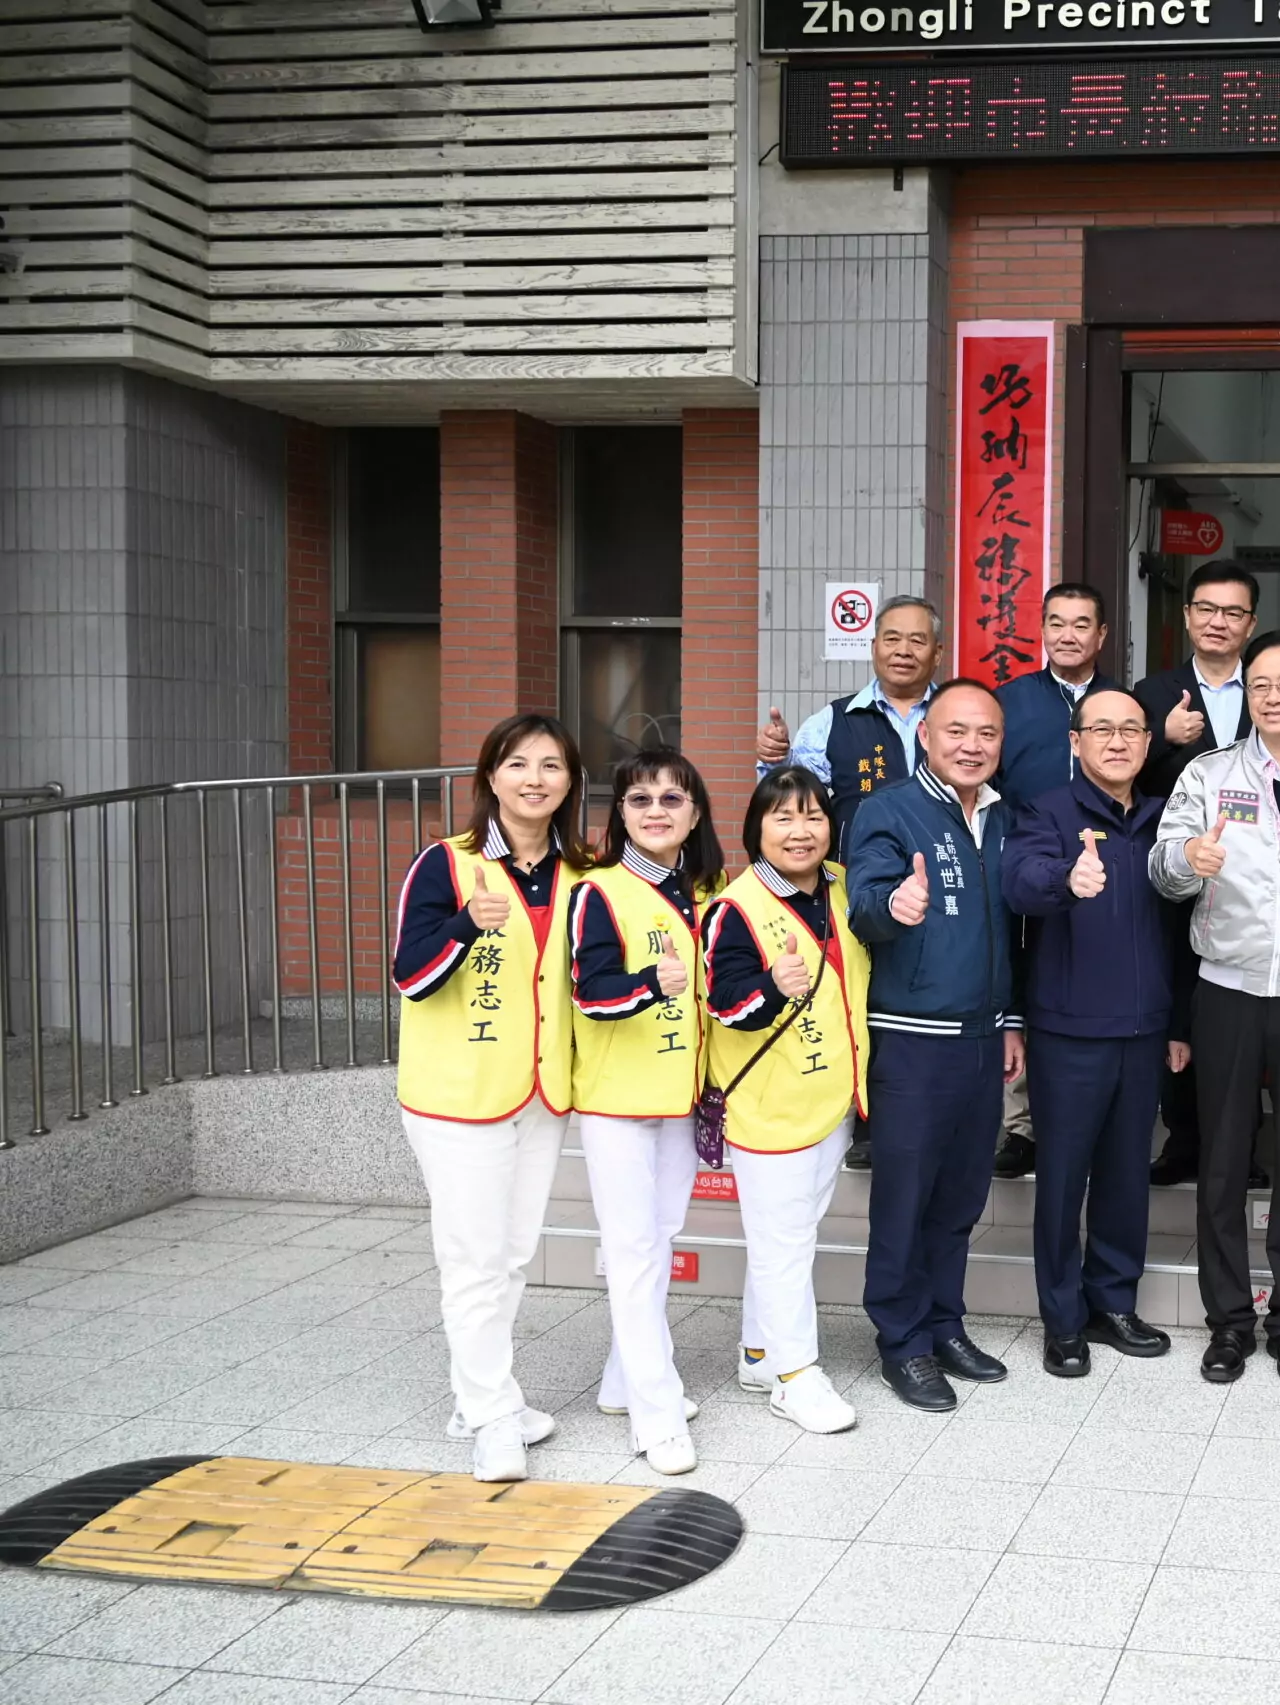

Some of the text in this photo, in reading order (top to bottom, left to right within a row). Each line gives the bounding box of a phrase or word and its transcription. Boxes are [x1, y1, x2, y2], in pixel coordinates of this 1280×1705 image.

[802, 0, 973, 39] Zhongli
[1004, 0, 1211, 30] Precinct
[874, 744, 886, 779] 中隊長
[933, 843, 959, 916] 高世嘉
[944, 832, 965, 889] 民防大隊長
[647, 930, 687, 1054] 服志工
[695, 1177, 733, 1188] 心台階
